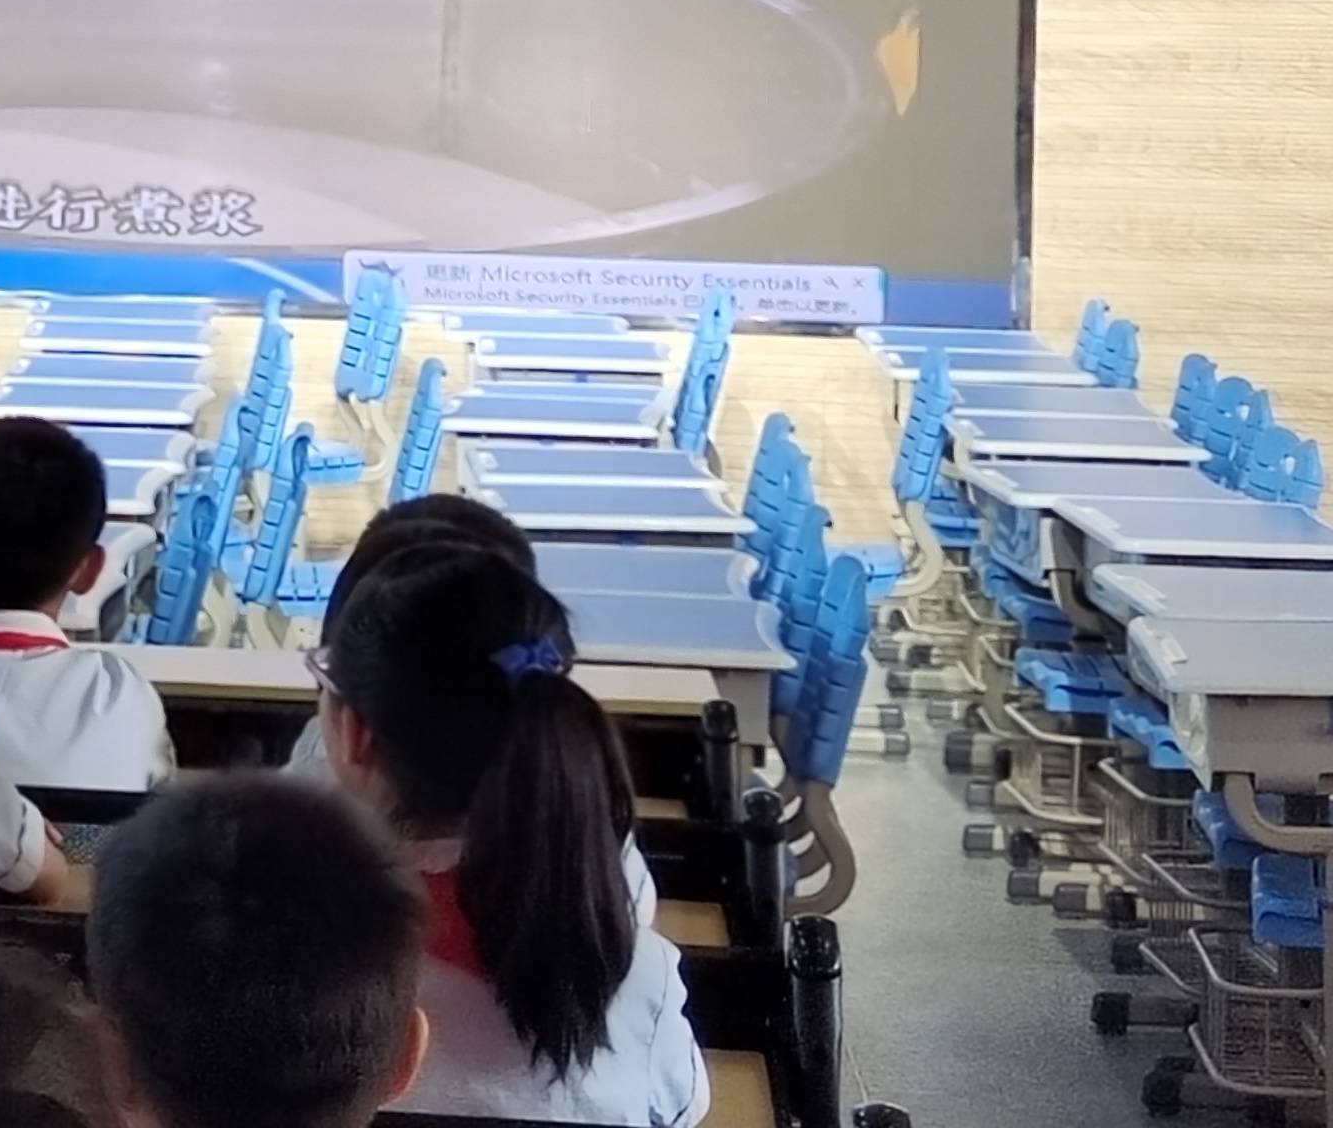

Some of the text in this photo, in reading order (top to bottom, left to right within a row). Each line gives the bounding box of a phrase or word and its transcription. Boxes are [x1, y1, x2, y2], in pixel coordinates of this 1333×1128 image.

[426, 264, 812, 293] 更新 Microsoft Security Essentials
[424, 287, 511, 304] Microsoft
[515, 290, 589, 307] Security
[592, 292, 678, 309] Essentials
